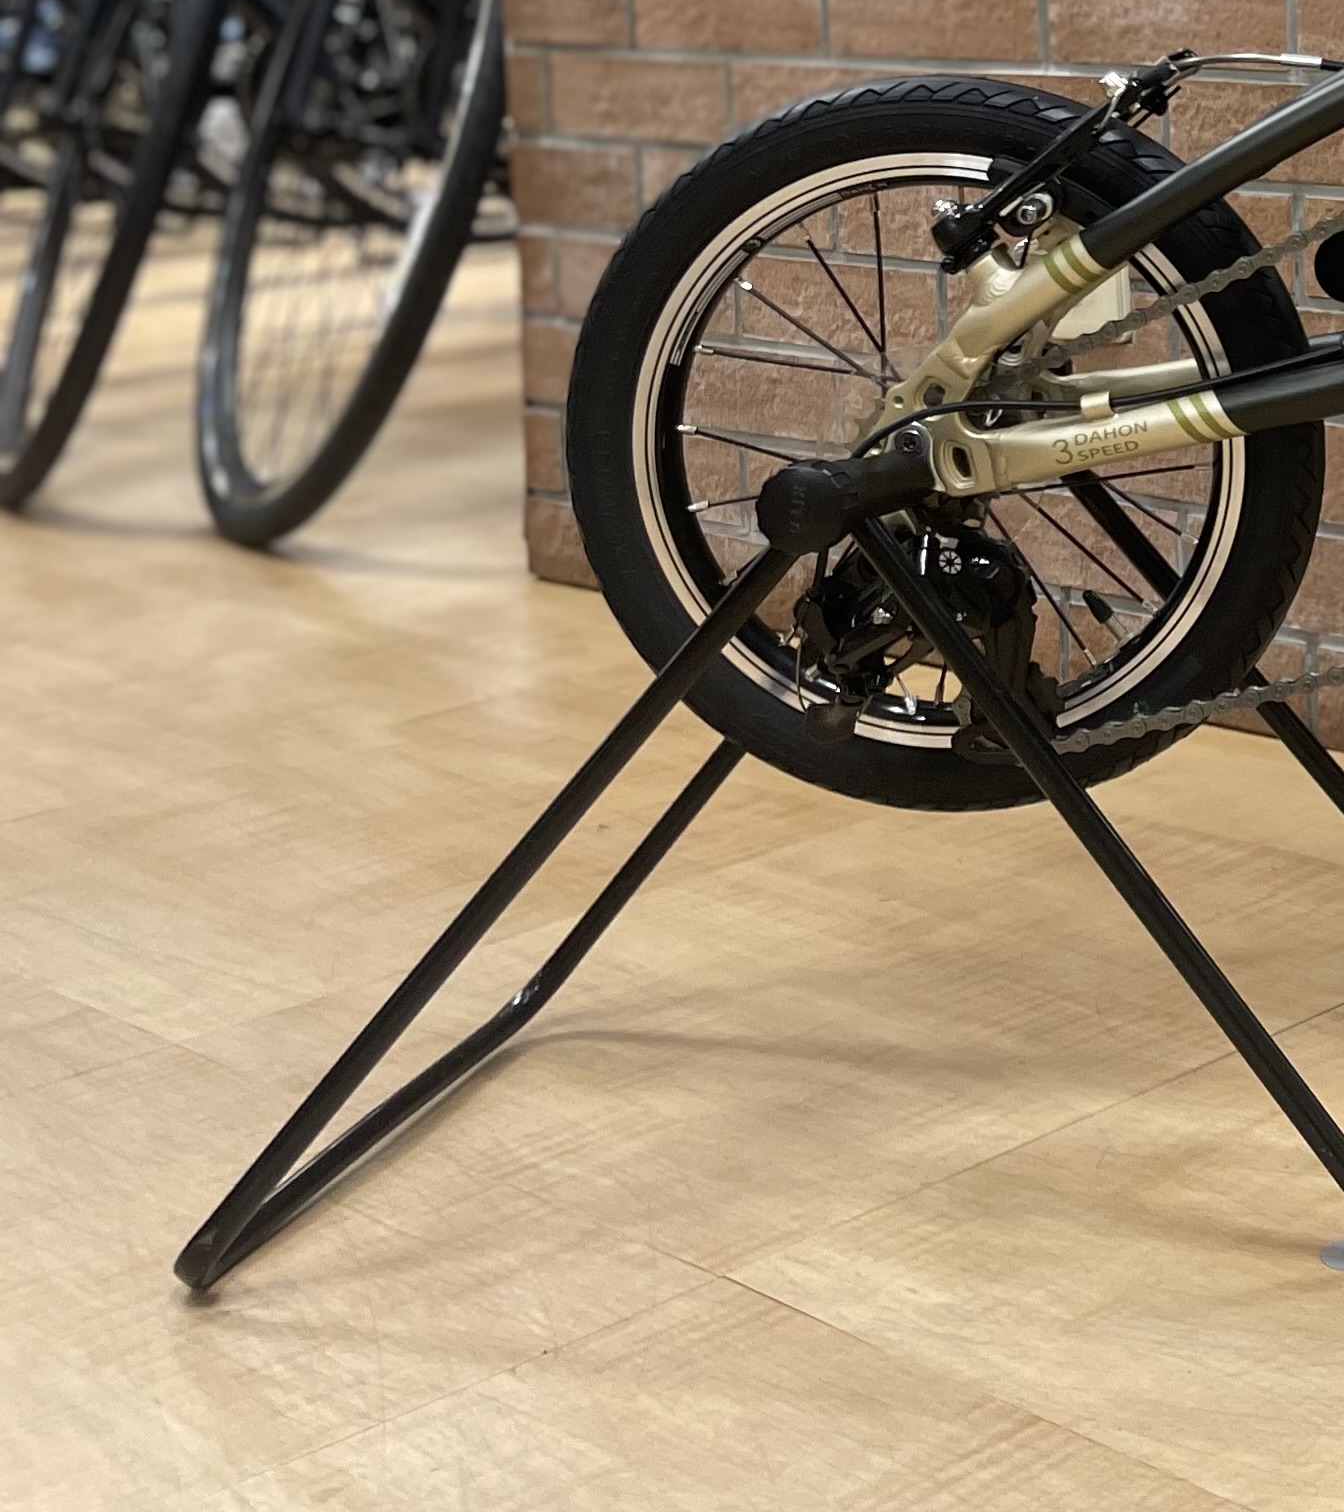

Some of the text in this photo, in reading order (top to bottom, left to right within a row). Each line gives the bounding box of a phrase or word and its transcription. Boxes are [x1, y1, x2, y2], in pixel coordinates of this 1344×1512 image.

[1052, 420, 1148, 465] 3 DAHON
[1077, 440, 1140, 463] SPEED
